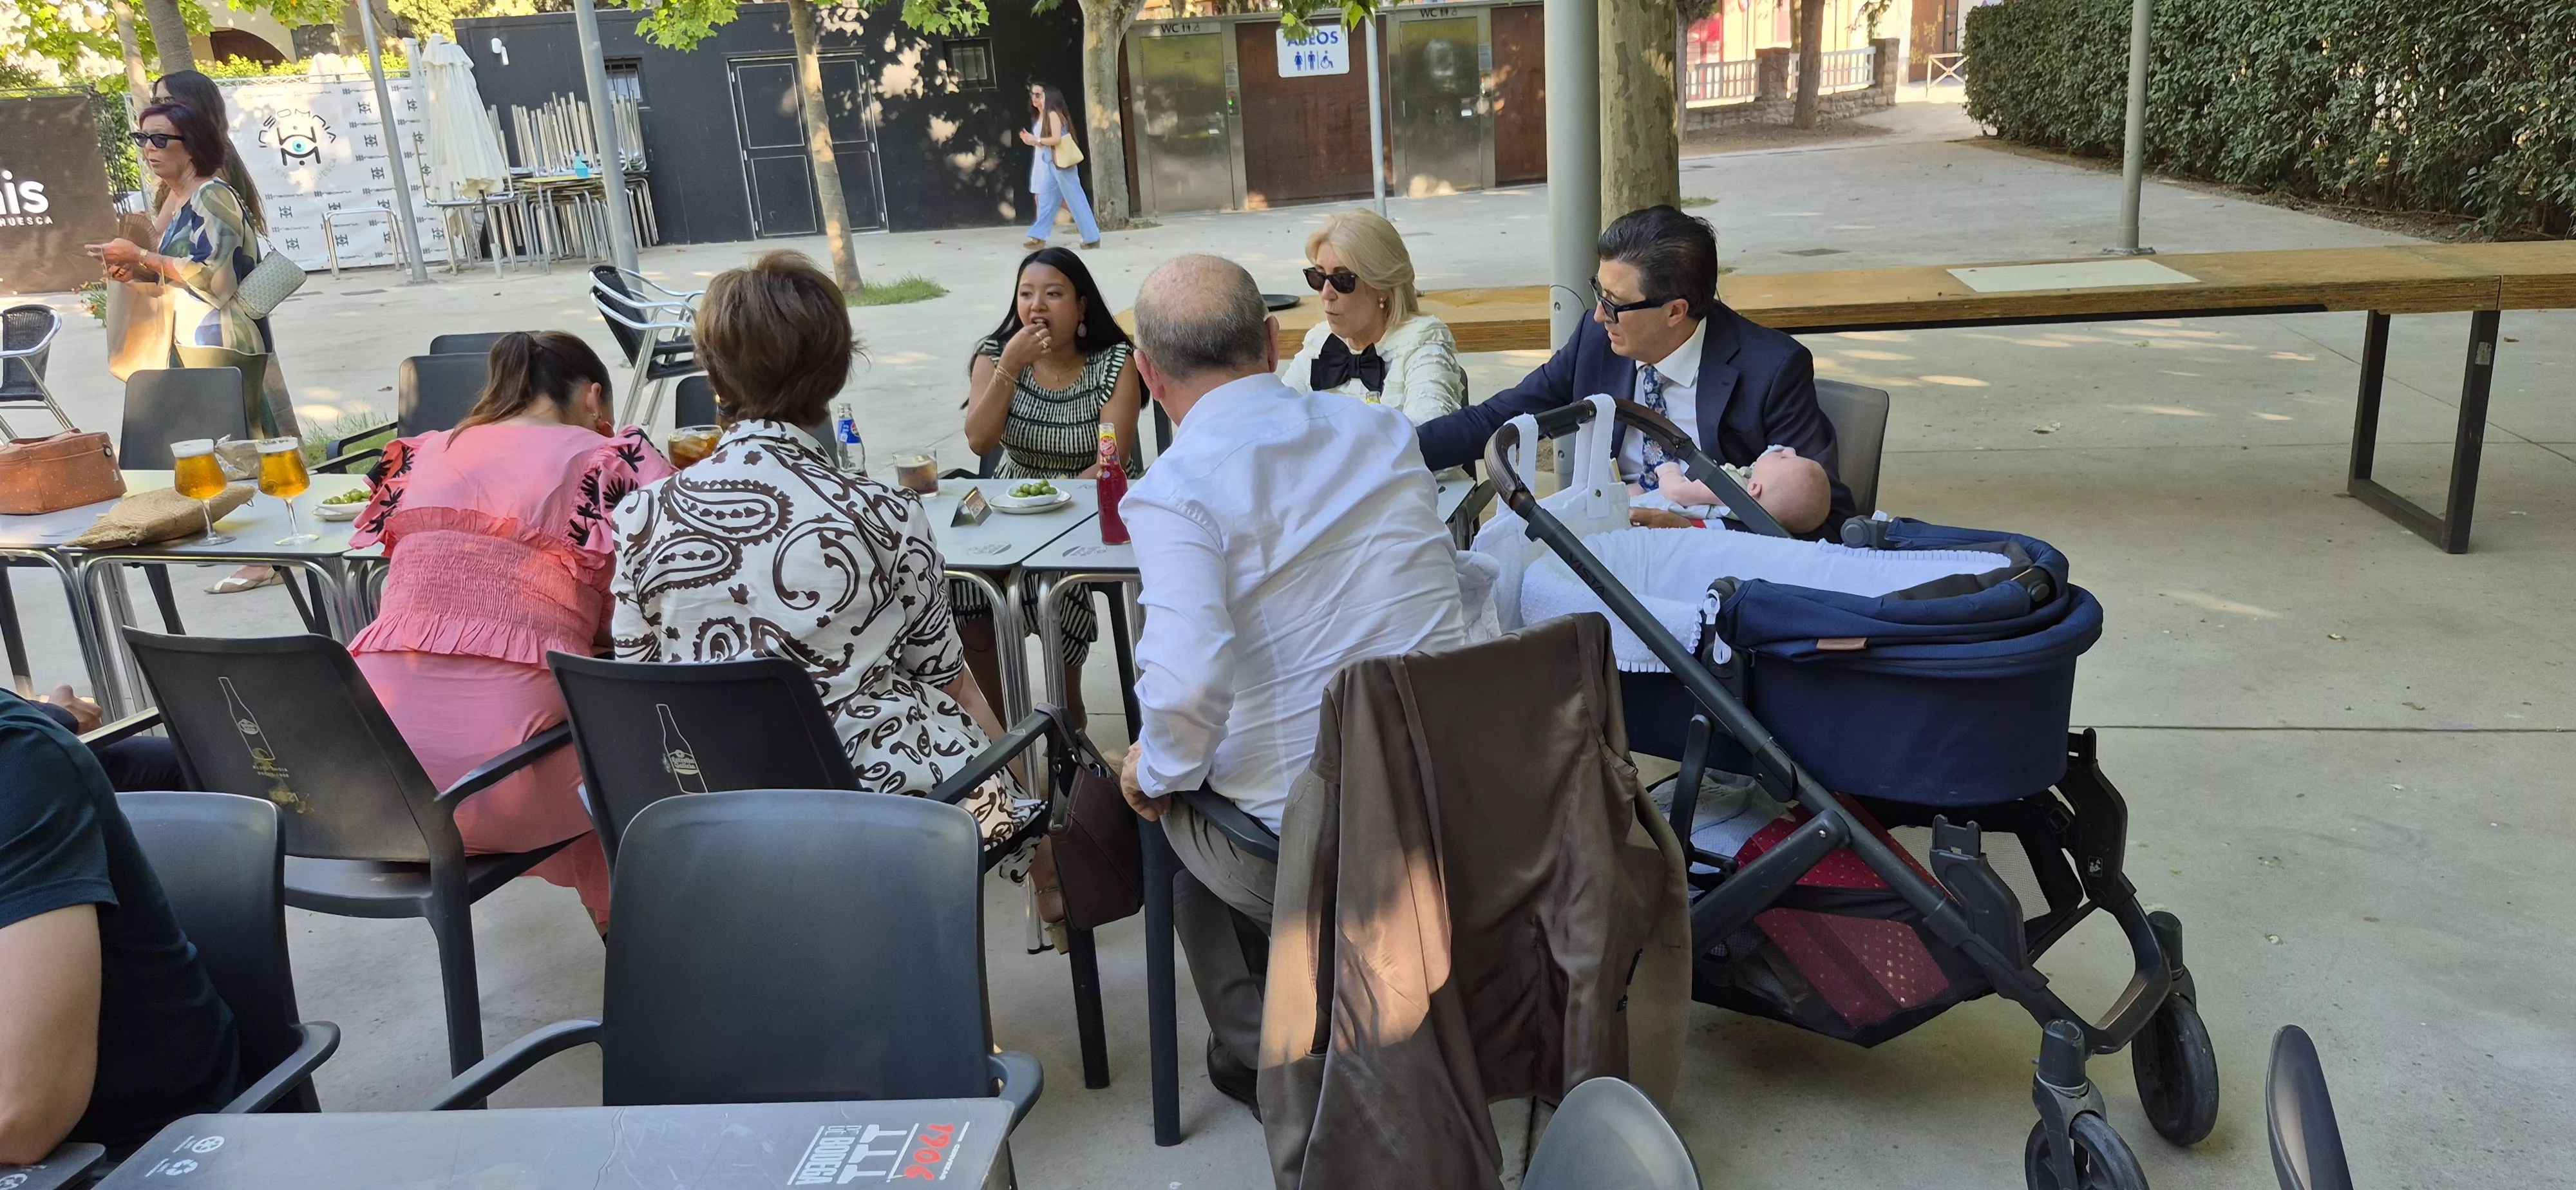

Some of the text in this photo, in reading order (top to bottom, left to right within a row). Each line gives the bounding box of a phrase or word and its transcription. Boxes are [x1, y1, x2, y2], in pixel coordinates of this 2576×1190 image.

[1160, 23, 1179, 33] WC
[1419, 8, 1437, 18] WC
[1569, 552, 1605, 597] VISTA
[795, 1137, 856, 1185] BODEGA
[904, 1123, 954, 1181] 1906
